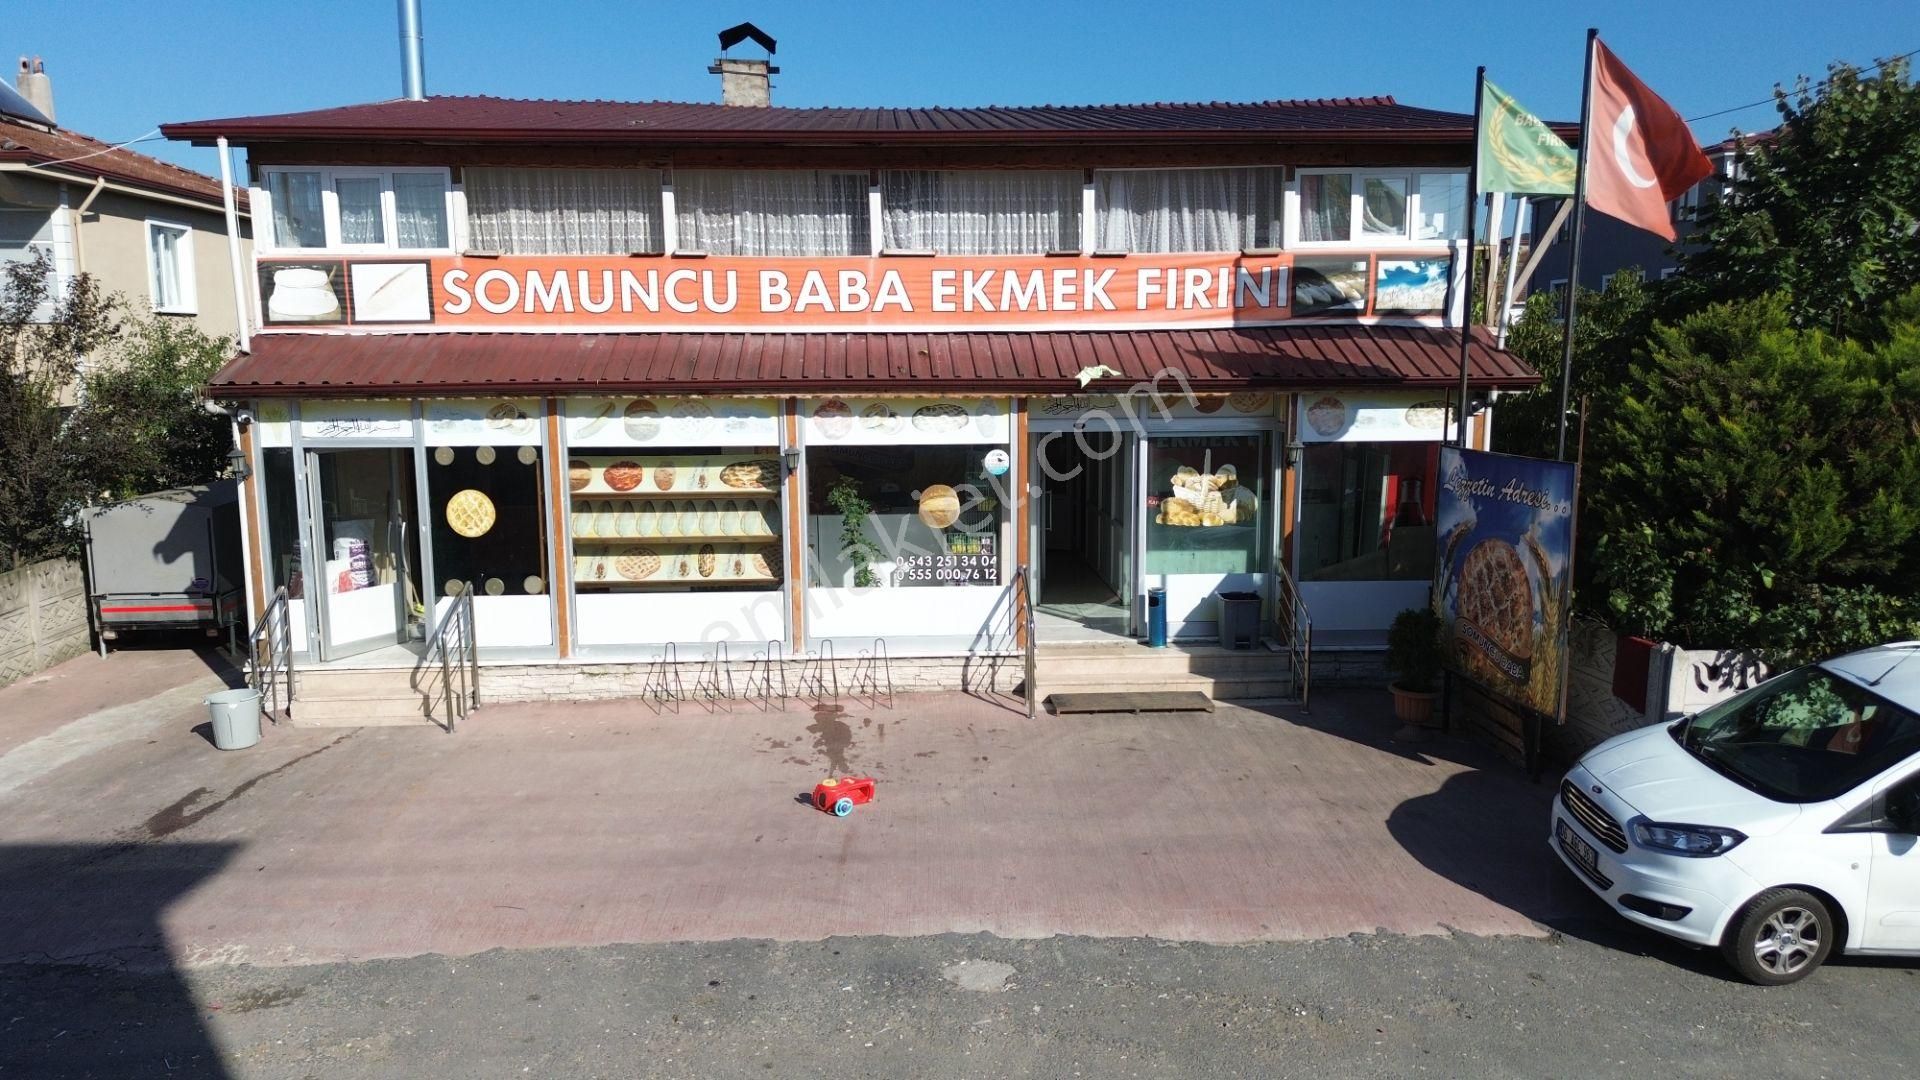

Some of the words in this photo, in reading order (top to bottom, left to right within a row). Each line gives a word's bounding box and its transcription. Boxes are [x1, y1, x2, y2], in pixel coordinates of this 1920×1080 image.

[442, 268, 739, 314] SOMUNCU
[759, 269, 914, 313] BABA
[931, 268, 1118, 312] EKMEK
[1136, 266, 1289, 311] FIRINI
[1443, 466, 1495, 502] Lezzetin
[896, 556, 904, 567] 0
[908, 556, 932, 567] 543
[936, 555, 958, 567] 251
[961, 556, 977, 567] 34
[981, 556, 997, 566] 04
[896, 569, 905, 580] 0
[908, 569, 932, 580] 555
[936, 569, 961, 580] 000
[965, 569, 980, 580] 76
[984, 569, 997, 580] 12
[1462, 623, 1501, 663] SOMUNCU
[1500, 655, 1524, 678] BABA
